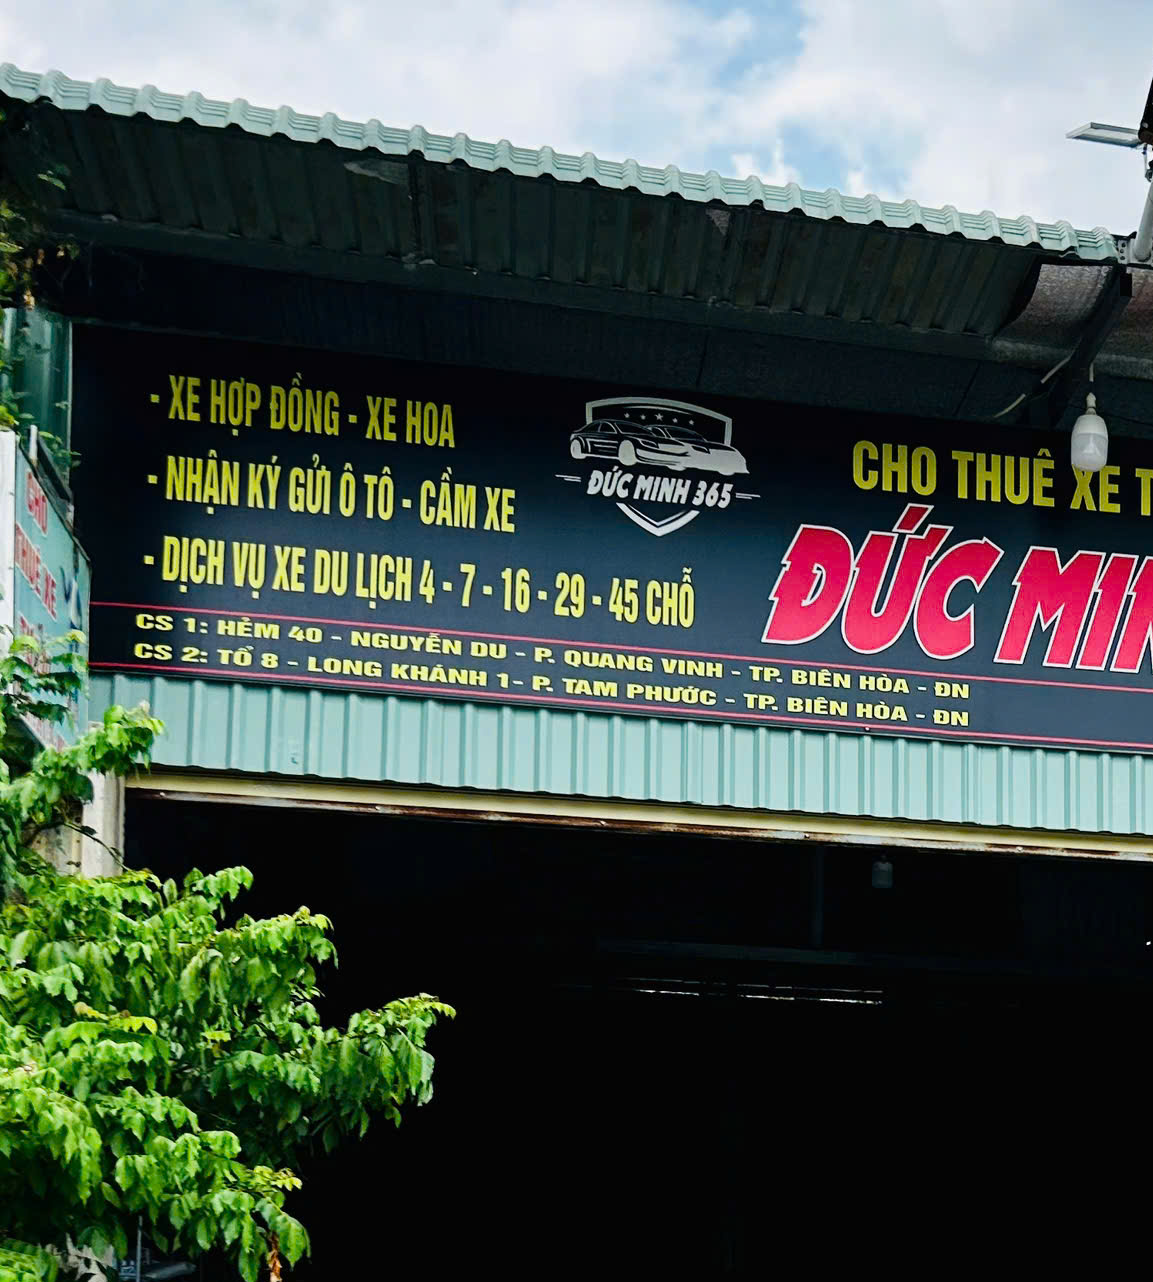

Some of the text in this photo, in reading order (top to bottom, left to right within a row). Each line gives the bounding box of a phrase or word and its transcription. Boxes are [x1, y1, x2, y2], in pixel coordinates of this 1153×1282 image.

[168, 375, 201, 422] XE
[210, 376, 261, 436] HỢP
[269, 372, 340, 436] ĐỒNG
[365, 395, 397, 442] XE
[405, 399, 455, 449] HOA
[165, 449, 240, 515] NHẬN
[247, 455, 282, 510] KÝ
[288, 453, 332, 515] GỬI
[339, 462, 356, 517] Ô
[363, 466, 395, 521] TÔ
[419, 466, 477, 529] CẦM
[483, 486, 516, 533] XE
[586, 465, 734, 509] ĐỨC MINH 365
[853, 440, 937, 497] CHO
[952, 449, 1054, 508] THUÊ
[1071, 462, 1121, 514] XE
[161, 535, 225, 593] DỊCH
[231, 541, 267, 600] VỤ
[271, 544, 307, 593] XE
[313, 548, 349, 597] DU
[355, 552, 413, 610] LỊCH
[418, 559, 436, 605] 4
[459, 563, 476, 608] 7
[500, 567, 531, 614] 16
[553, 571, 586, 619] 29
[608, 577, 639, 624] 45
[645, 566, 695, 628] CHỖ
[762, 503, 1004, 660] ĐỨC
[133, 642, 173, 661] CS
[180, 646, 209, 664] 2:
[216, 645, 255, 667] TỔ
[260, 652, 279, 669] 8
[307, 655, 383, 678] LONG
[390, 662, 488, 687] KHÁNH
[531, 675, 554, 693] P.
[561, 677, 618, 698] TAM
[626, 683, 717, 706] PHƯỚC
[742, 692, 779, 711] TP.
[786, 696, 848, 717] BIÊN
[855, 700, 909, 722] HÒA
[932, 709, 969, 727] ĐN
[135, 613, 174, 631] CS
[183, 617, 209, 634] 1:
[216, 616, 281, 640] HẺM
[287, 625, 323, 644] 40
[350, 630, 463, 656] NGUYỄN
[469, 640, 507, 660] DU
[533, 646, 556, 664] P.
[563, 649, 654, 673] QUANG
[660, 657, 723, 679] VINH
[748, 665, 784, 684] TP.
[791, 668, 851, 689] BIÊN
[859, 672, 910, 694] HÒA
[933, 681, 970, 699] ĐN
